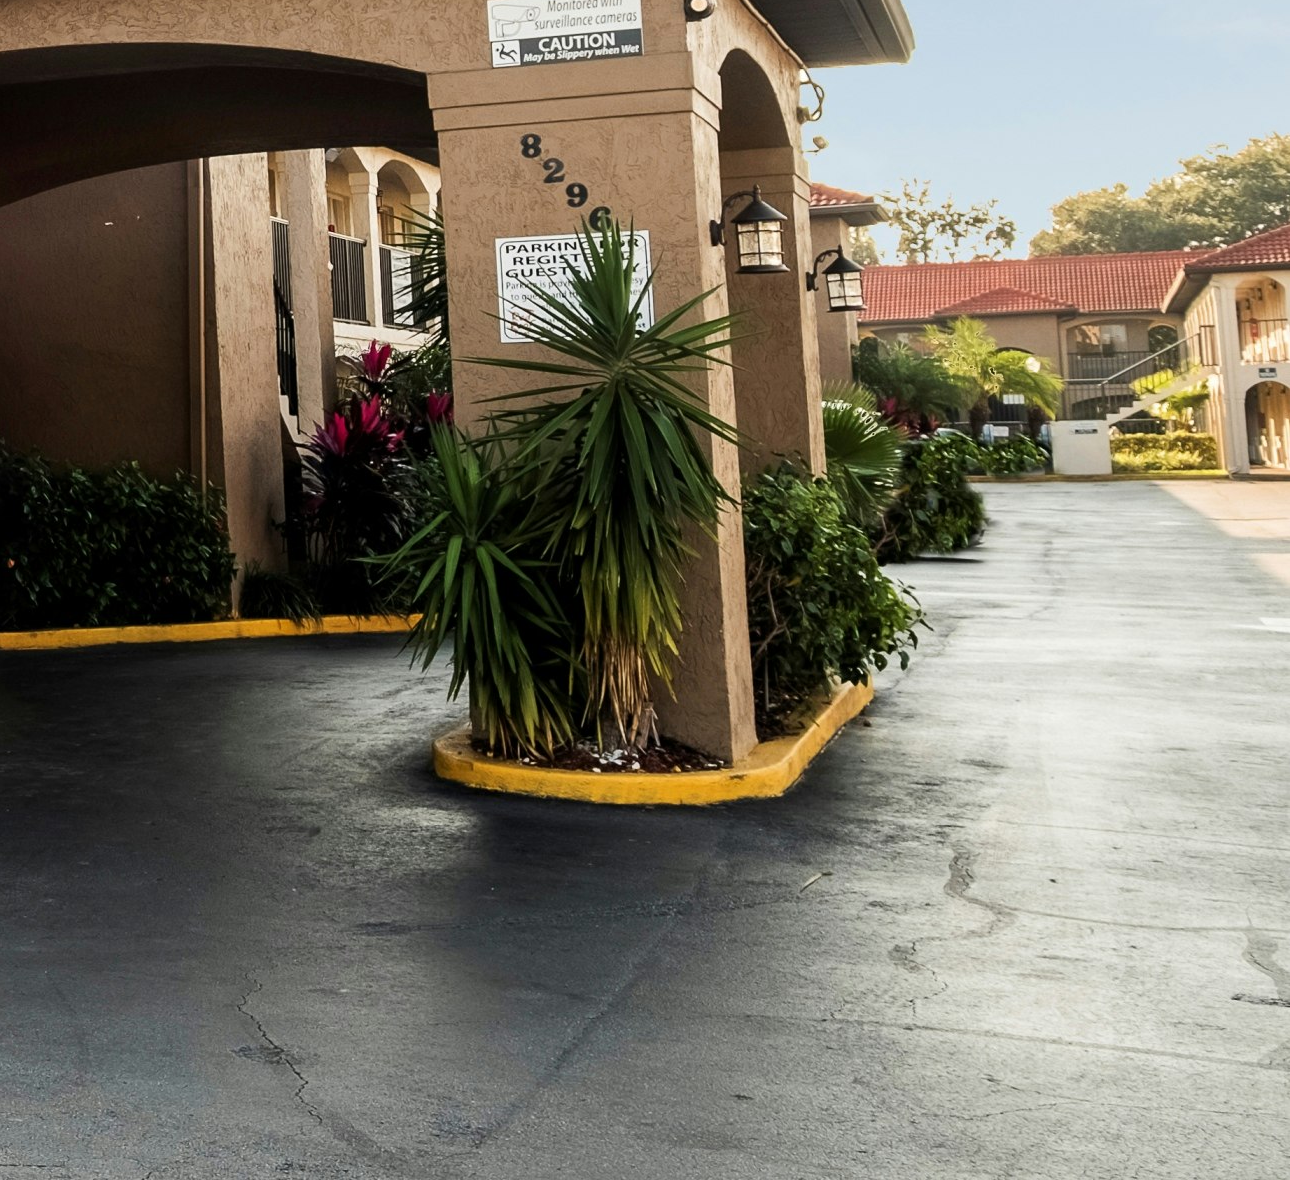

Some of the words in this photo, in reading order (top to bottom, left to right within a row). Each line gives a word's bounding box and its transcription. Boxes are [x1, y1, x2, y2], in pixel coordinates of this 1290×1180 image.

[534, 14, 593, 30] surveillance
[595, 11, 638, 25] cameras
[538, 32, 616, 52] CAUTION
[523, 53, 543, 63] May
[544, 51, 556, 61] be
[557, 48, 594, 61] Slippery
[595, 46, 620, 56] when
[621, 44, 640, 54] Wet
